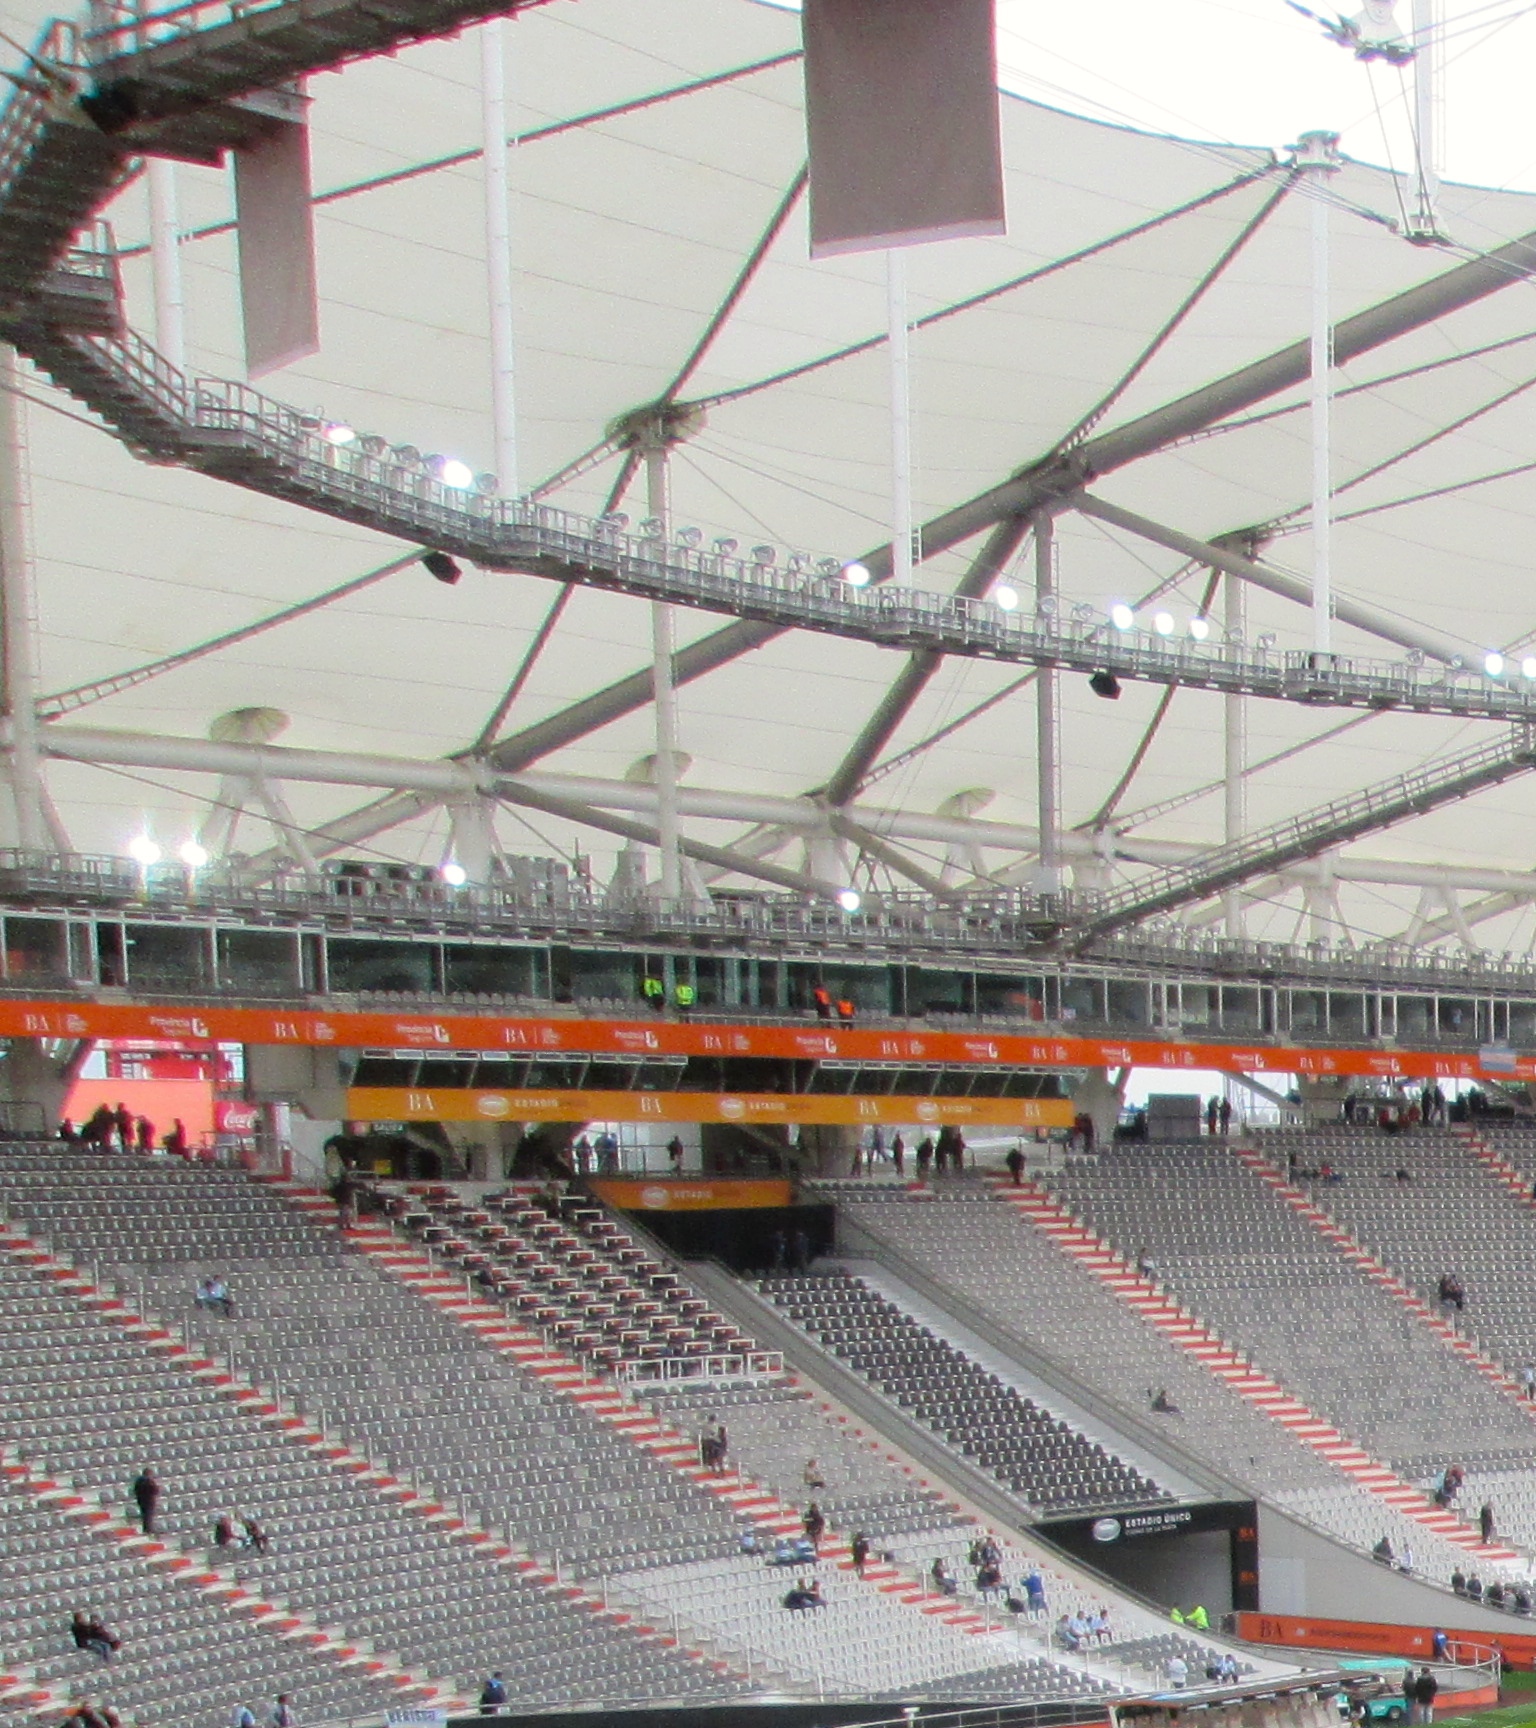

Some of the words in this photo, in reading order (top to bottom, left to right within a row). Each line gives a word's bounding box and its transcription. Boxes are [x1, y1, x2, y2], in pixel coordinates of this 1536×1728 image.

[25, 1014, 49, 1031] BA
[274, 1022, 299, 1039] BA
[505, 1027, 527, 1044] BA
[704, 1035, 722, 1049] BA
[408, 1093, 434, 1111] BA
[640, 1096, 663, 1113] BA
[859, 1101, 878, 1116] BA
[1125, 1515, 1163, 1528] ESTADIO
[1164, 1512, 1192, 1524] ÚNICO
